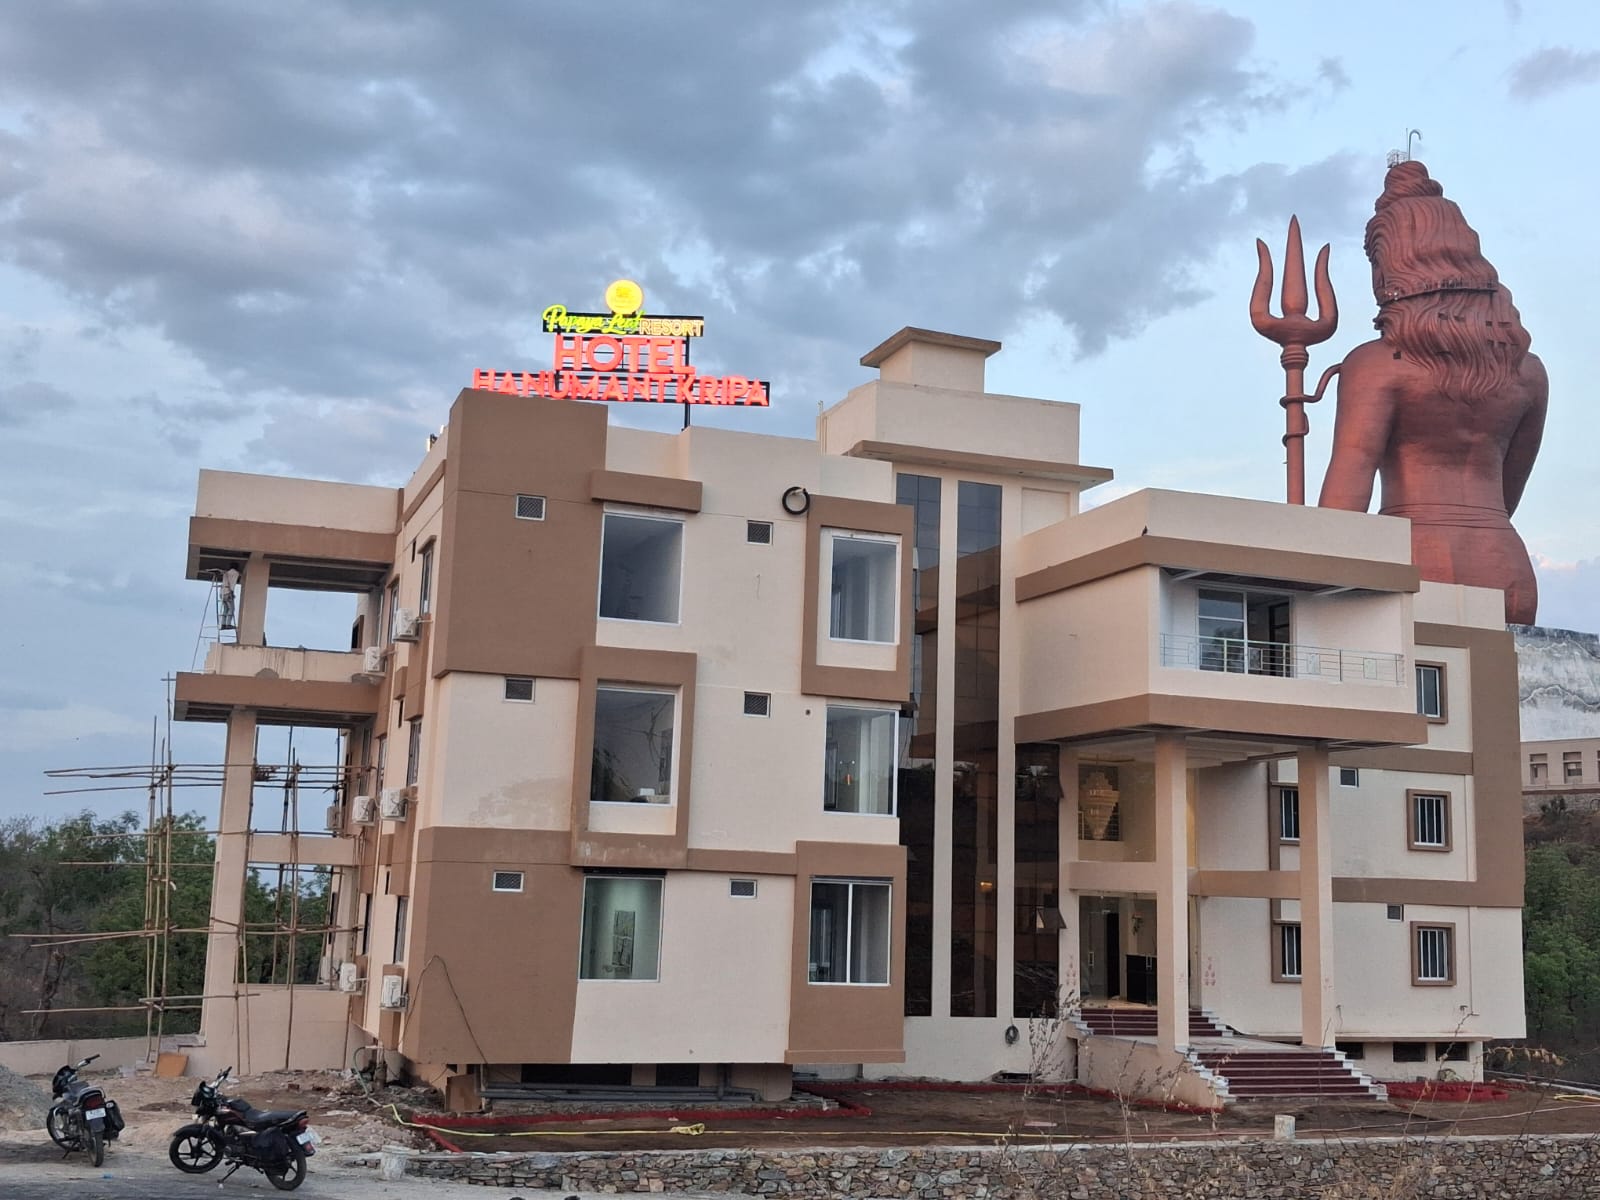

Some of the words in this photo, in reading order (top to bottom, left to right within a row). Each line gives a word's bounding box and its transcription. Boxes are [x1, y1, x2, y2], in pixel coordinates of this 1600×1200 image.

[543, 304, 602, 332] Papaya
[639, 318, 704, 335] RESORT
[554, 334, 695, 374] HOTEL
[473, 368, 673, 401] HANUMANT
[676, 374, 769, 405] KRIPA
